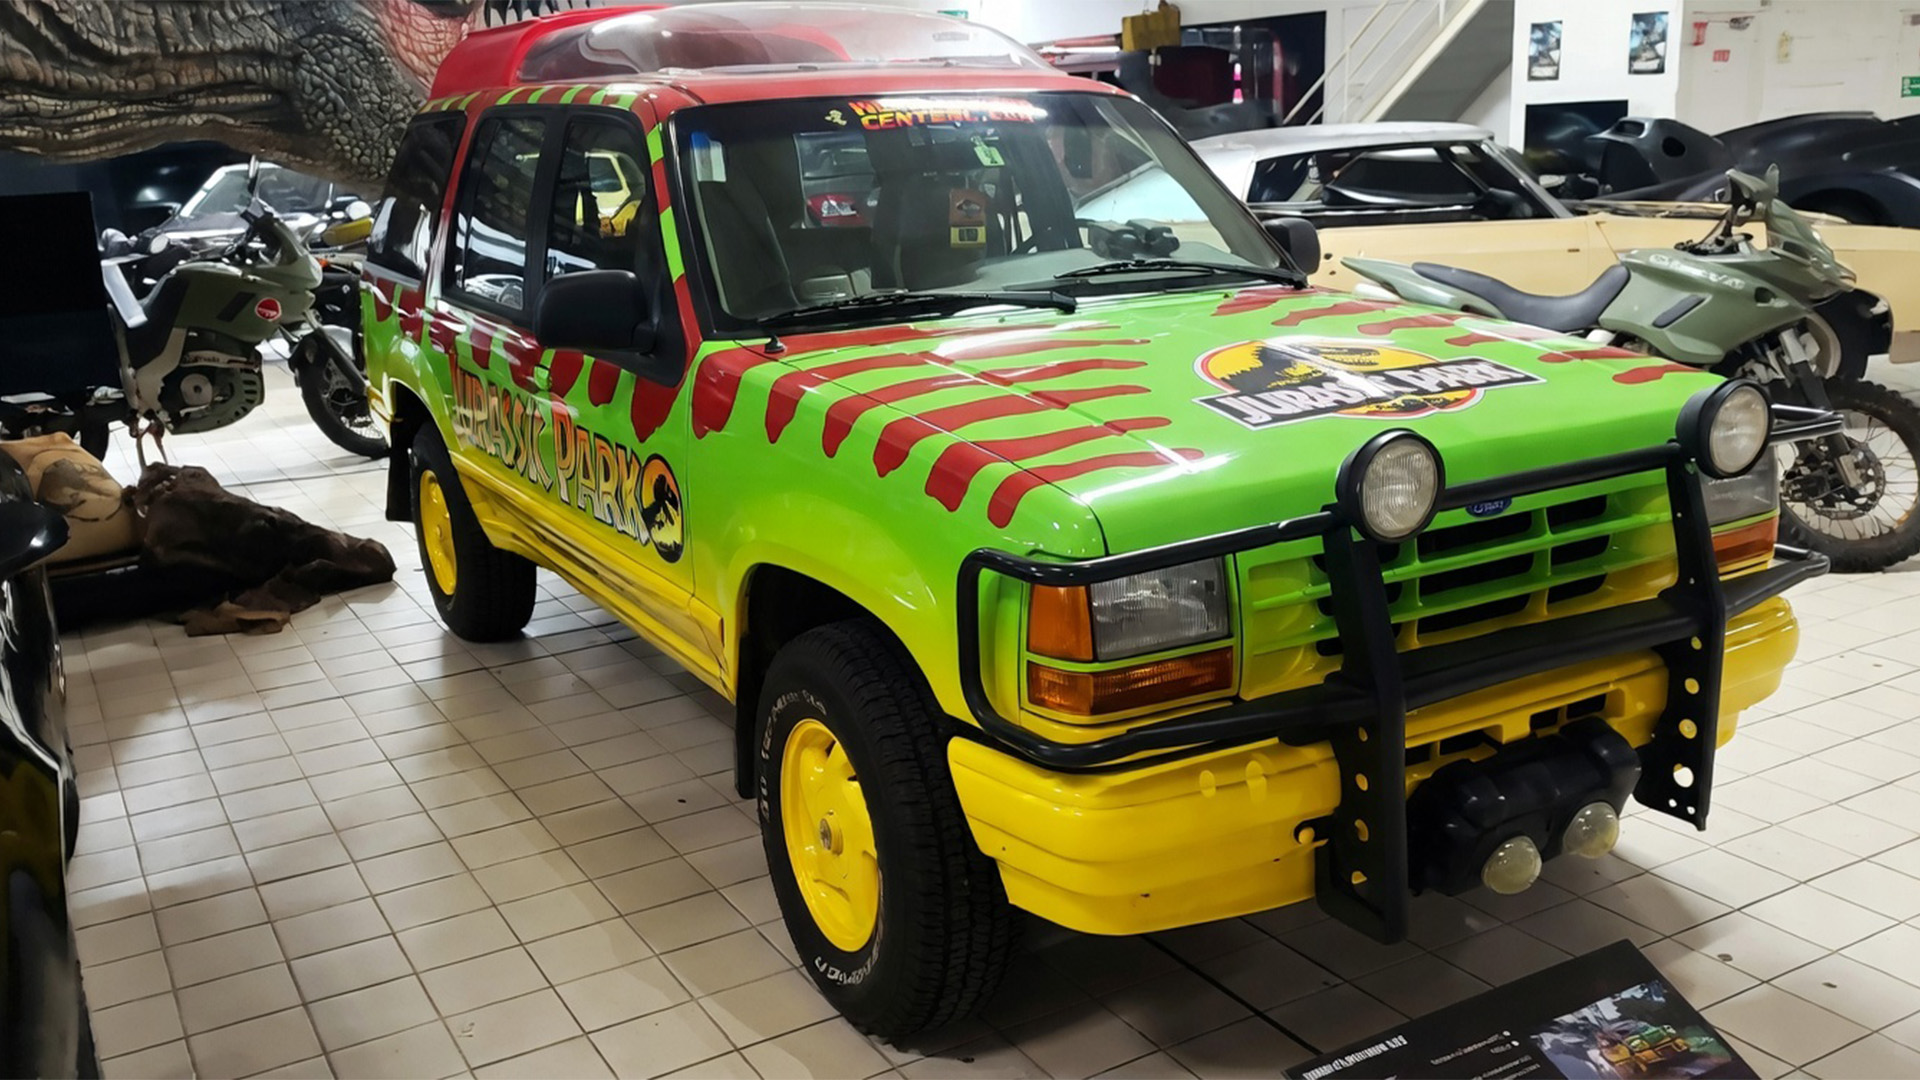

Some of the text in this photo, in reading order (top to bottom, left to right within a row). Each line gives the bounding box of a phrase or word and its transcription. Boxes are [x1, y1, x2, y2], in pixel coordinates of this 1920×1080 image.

[1217, 361, 1526, 425] JURASC PARK
[552, 402, 650, 546] PARK
